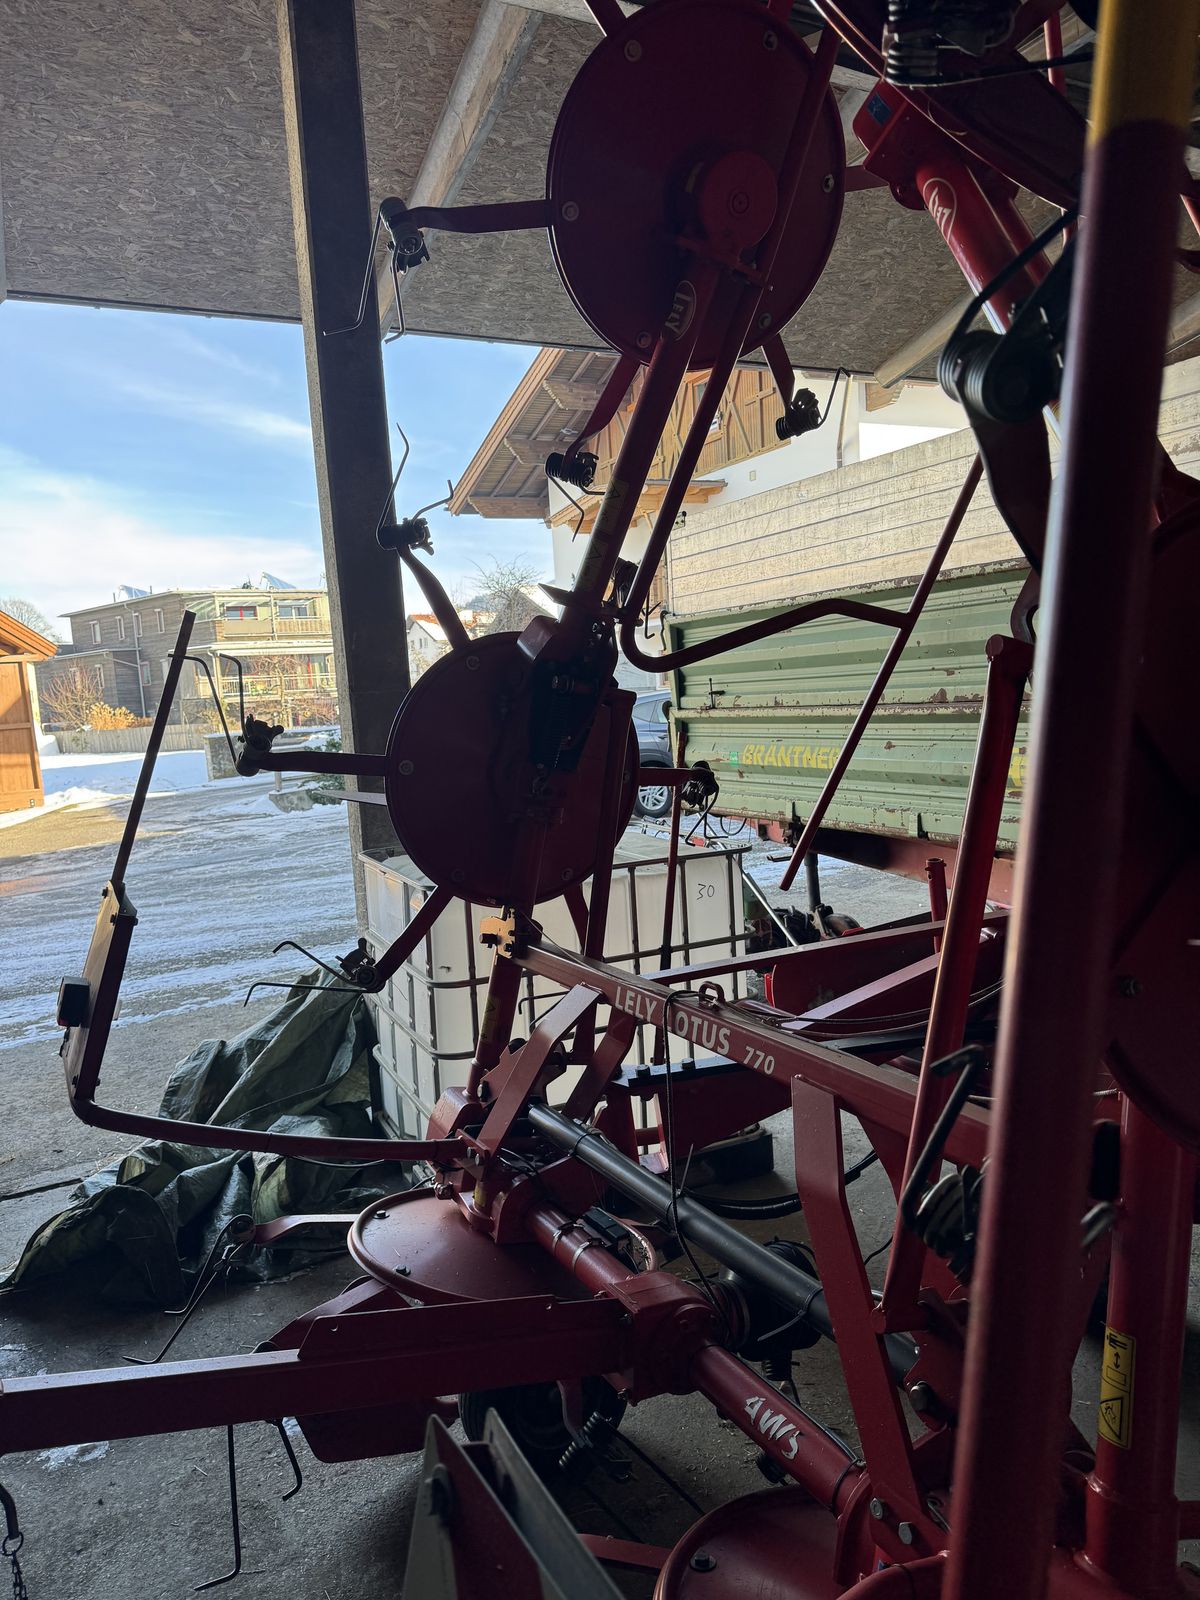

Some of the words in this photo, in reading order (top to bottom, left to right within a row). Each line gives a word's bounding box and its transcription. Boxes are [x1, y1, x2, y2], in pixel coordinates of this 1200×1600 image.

[697, 883, 715, 901] 30
[614, 986, 658, 1020] LELY
[743, 1045, 775, 1075] 770
[744, 1396, 801, 1460] 4WS
